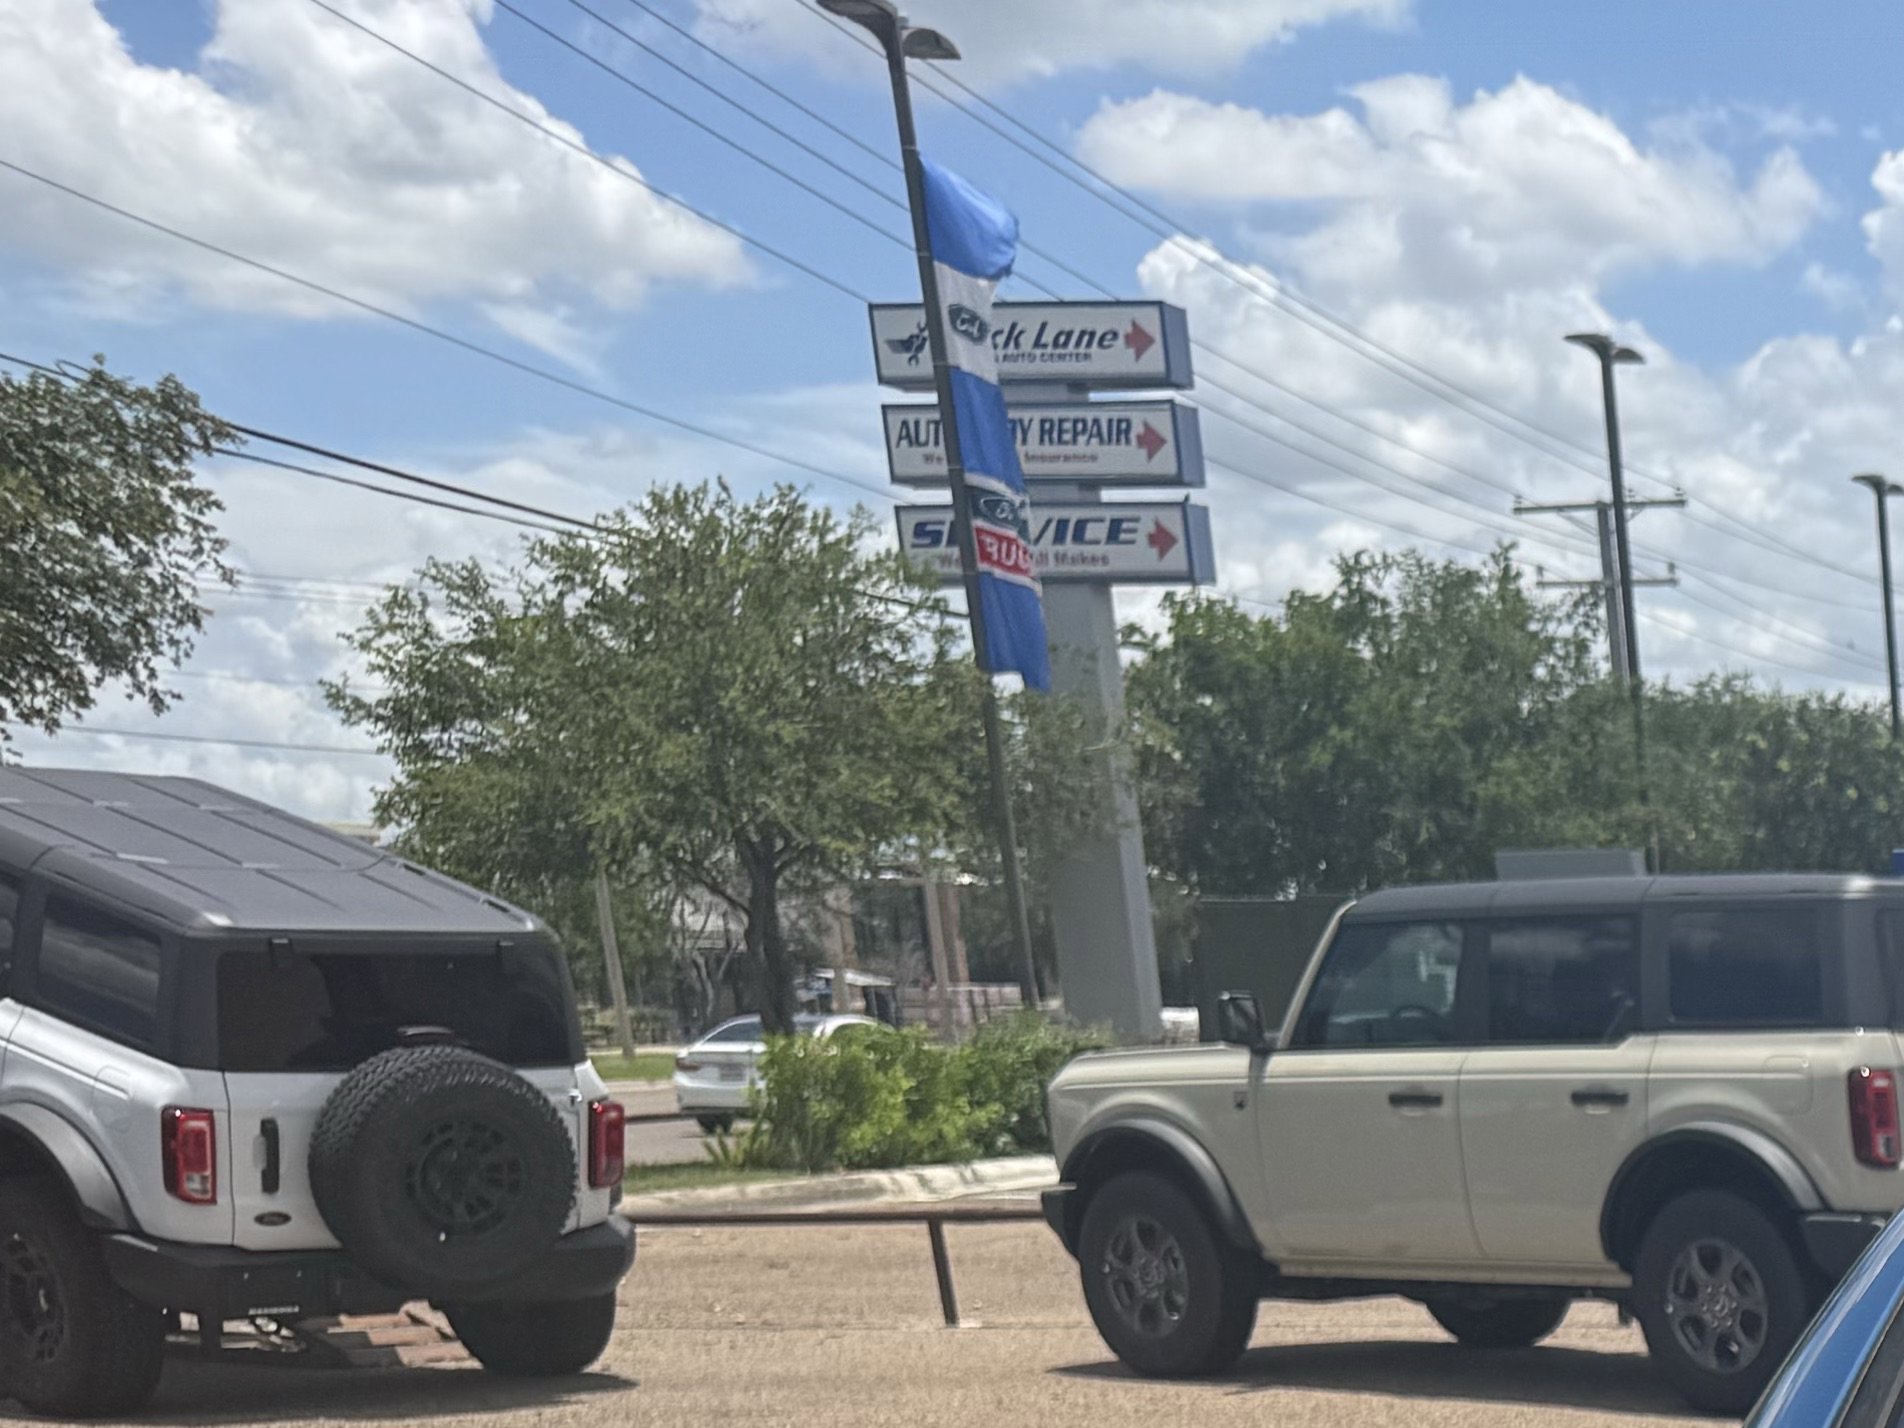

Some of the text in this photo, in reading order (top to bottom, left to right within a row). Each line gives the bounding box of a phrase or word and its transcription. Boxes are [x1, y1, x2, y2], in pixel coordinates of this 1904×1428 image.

[1032, 320, 1120, 350] Lane
[895, 417, 943, 449] AUT
[1038, 416, 1132, 447] REPAIR
